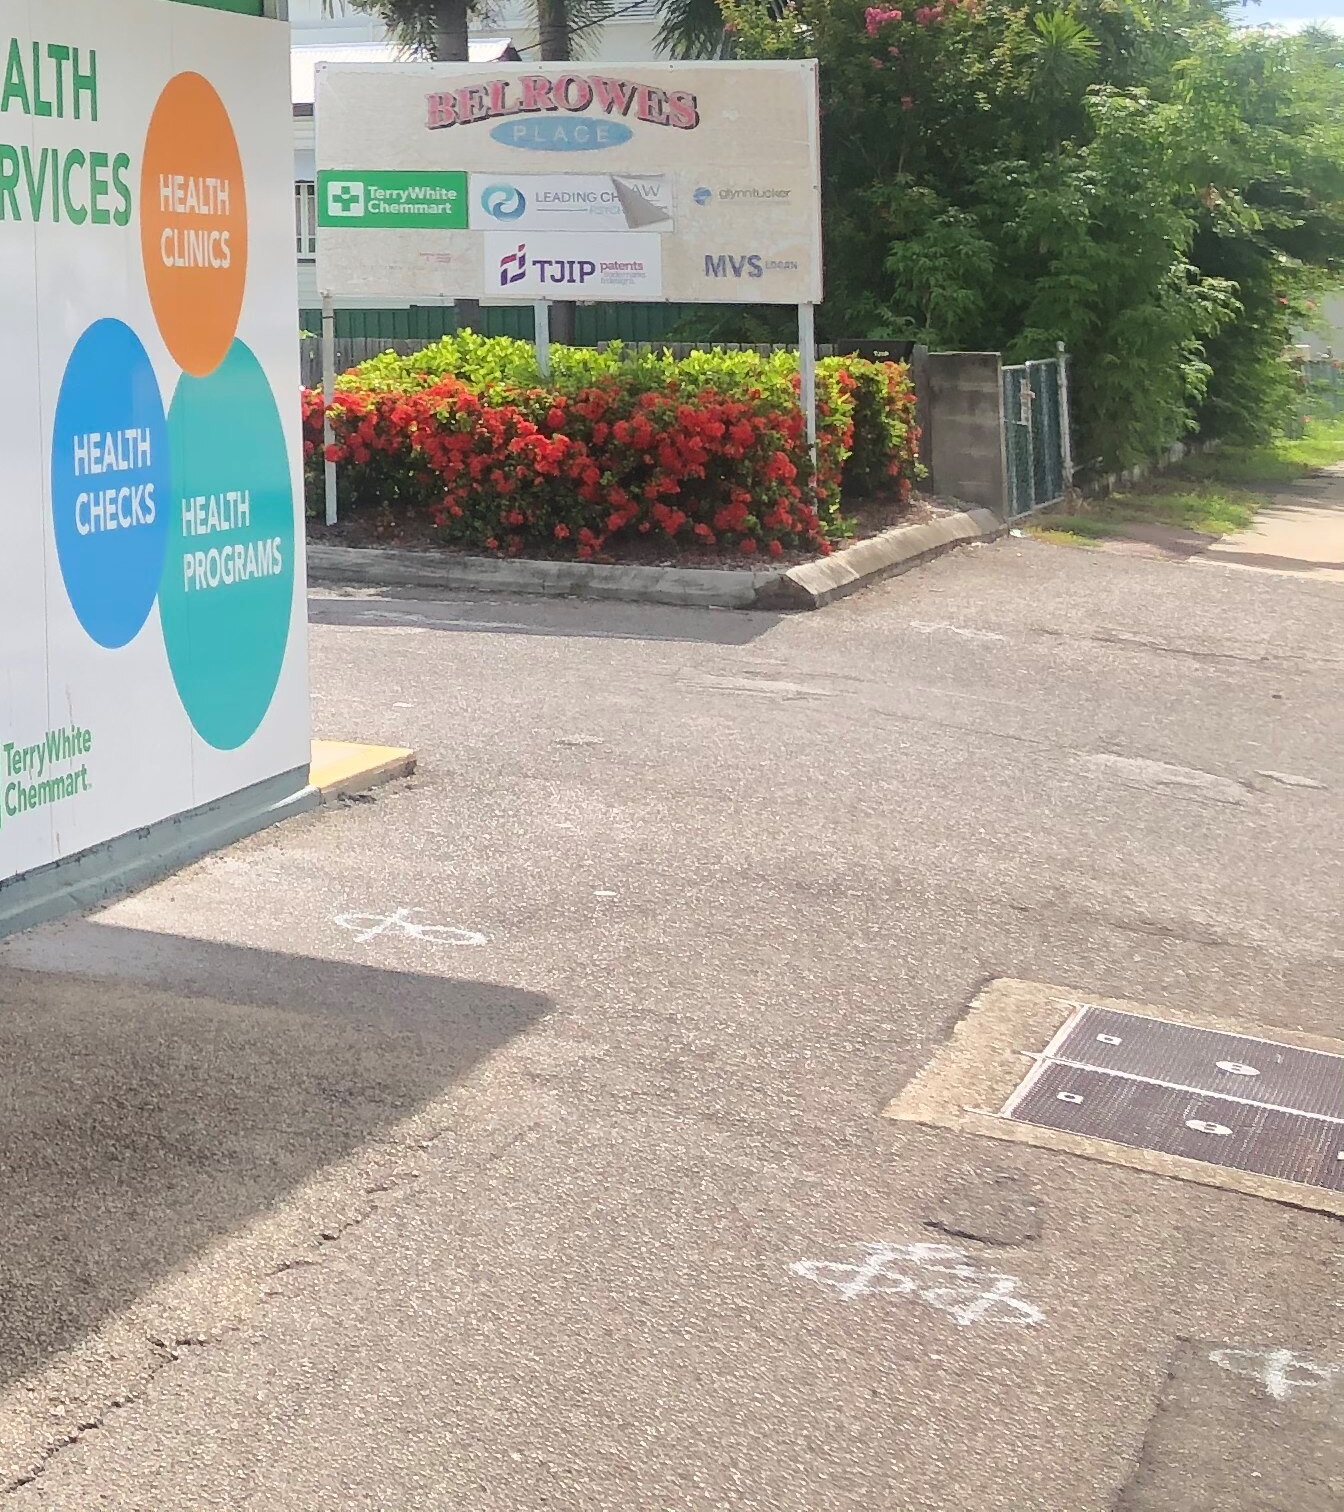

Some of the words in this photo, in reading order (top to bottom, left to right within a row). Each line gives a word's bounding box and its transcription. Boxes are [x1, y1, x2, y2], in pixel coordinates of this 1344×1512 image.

[424, 74, 701, 130] BELROWES
[513, 124, 610, 143] PLACE
[158, 174, 230, 217] HEALTH
[367, 185, 458, 201] TerryWhite
[367, 200, 452, 215] Chemmart
[535, 191, 597, 204] LEADING
[719, 187, 792, 200] glynntucker
[160, 229, 231, 269] CLINICS
[704, 254, 763, 278] MVS
[532, 260, 596, 284] TJIP
[599, 260, 643, 274] patents
[72, 427, 152, 477] HEALTH
[74, 483, 157, 537] CHECKS
[181, 490, 250, 538] HEALTH
[183, 537, 283, 593] PROGRAMS
[3, 724, 93, 781] TerryWhite
[4, 766, 91, 818] Chemmart
